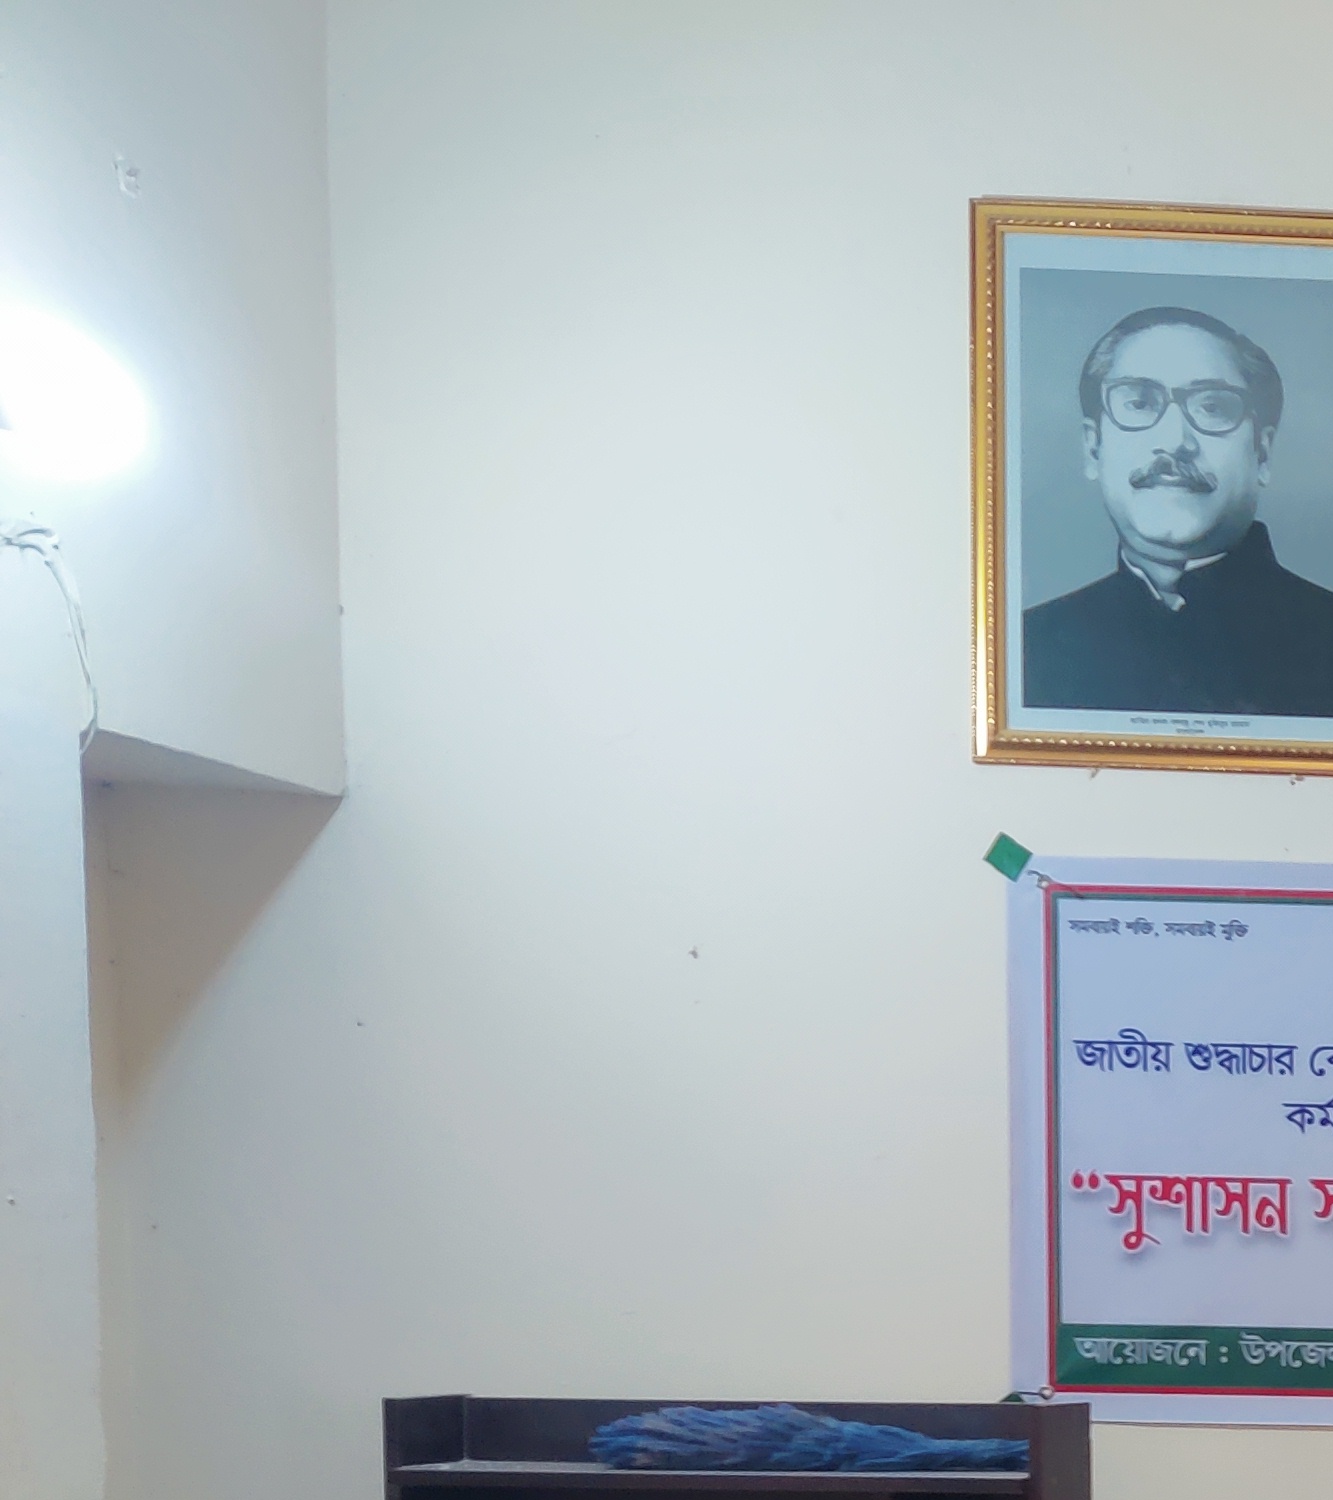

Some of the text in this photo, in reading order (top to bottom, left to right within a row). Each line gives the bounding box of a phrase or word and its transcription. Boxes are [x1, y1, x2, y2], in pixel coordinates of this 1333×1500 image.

[1073, 1029, 1174, 1072] জাতীয়
[1184, 1043, 1298, 1075] শুদ্ধাচার
[1074, 1338, 1209, 1365] আয়োজনে
